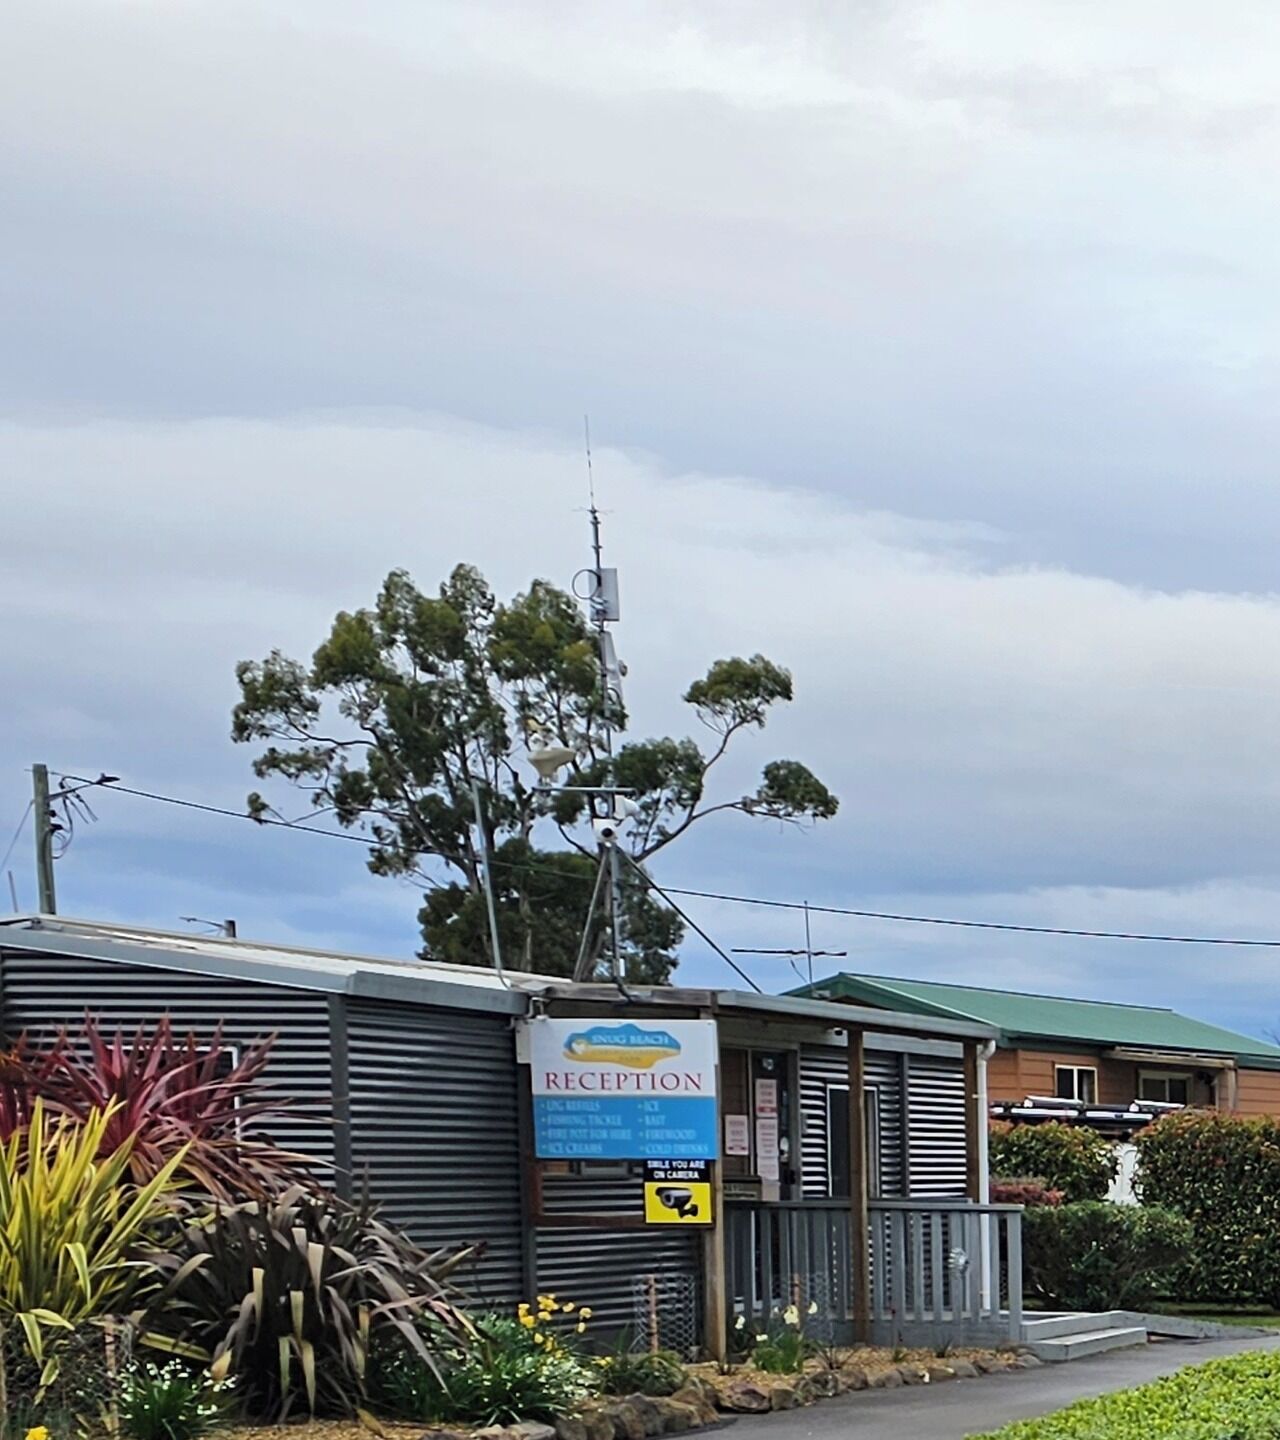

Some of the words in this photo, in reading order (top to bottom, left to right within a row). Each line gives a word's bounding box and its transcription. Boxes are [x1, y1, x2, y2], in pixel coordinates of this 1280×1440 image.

[545, 1072, 702, 1091] RECEPTION
[672, 1160, 688, 1169] YOU
[689, 1160, 705, 1169] ARE
[653, 1170, 665, 1179] ON
[667, 1170, 699, 1179] CAMERA
